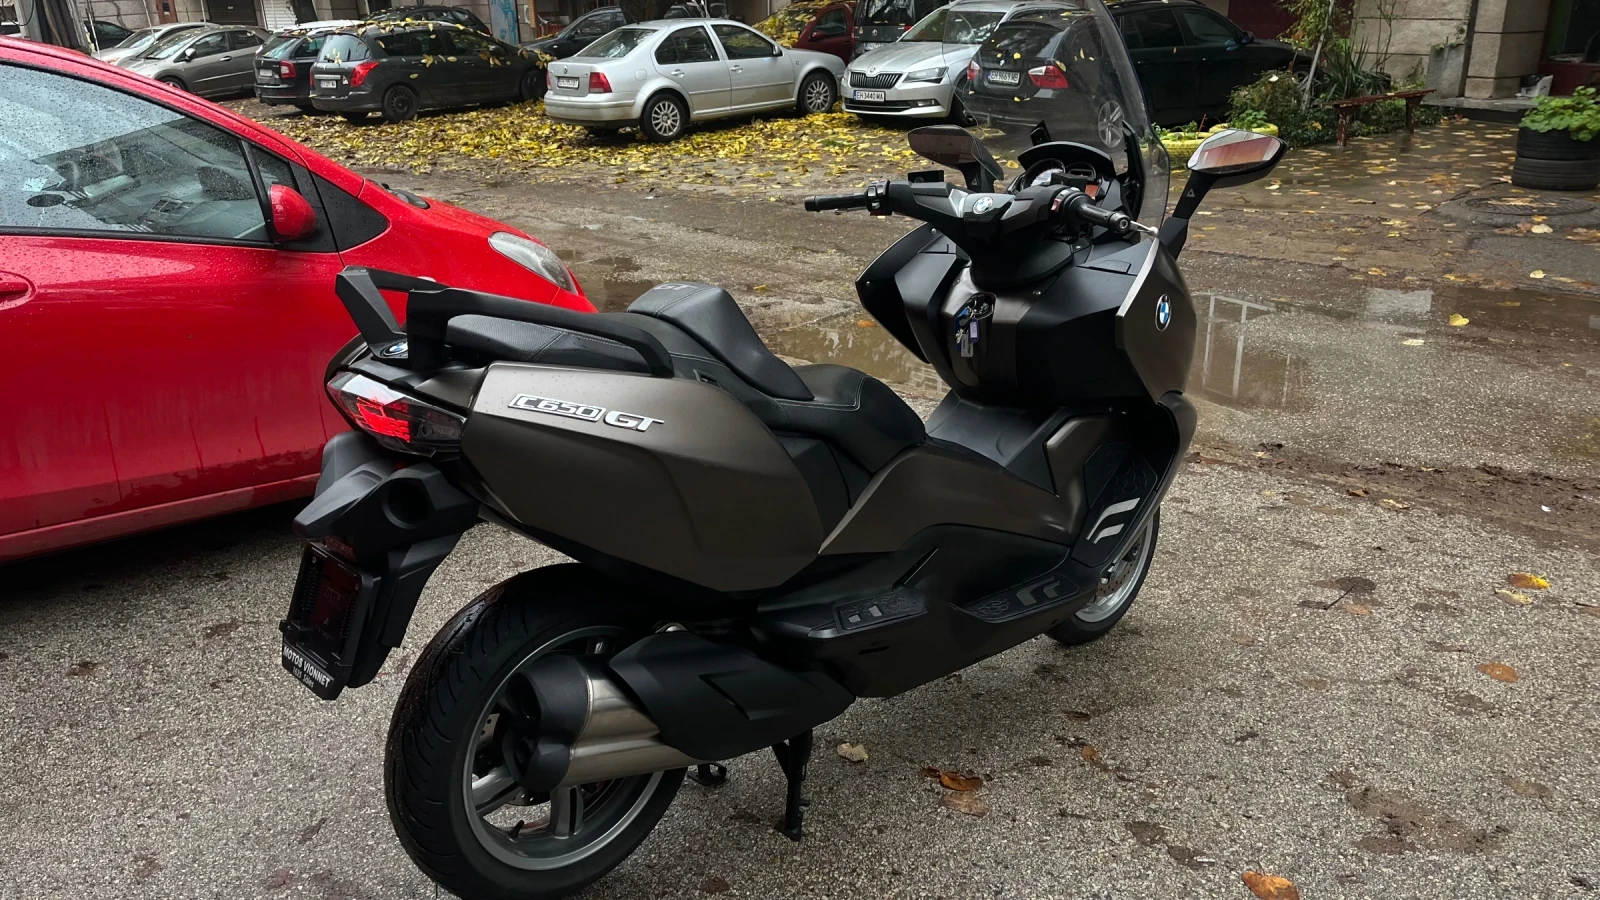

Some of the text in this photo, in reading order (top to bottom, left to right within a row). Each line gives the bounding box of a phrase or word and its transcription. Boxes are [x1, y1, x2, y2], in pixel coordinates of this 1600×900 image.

[603, 410, 665, 433] GT
[283, 646, 330, 687] MOTOS VIONNET
